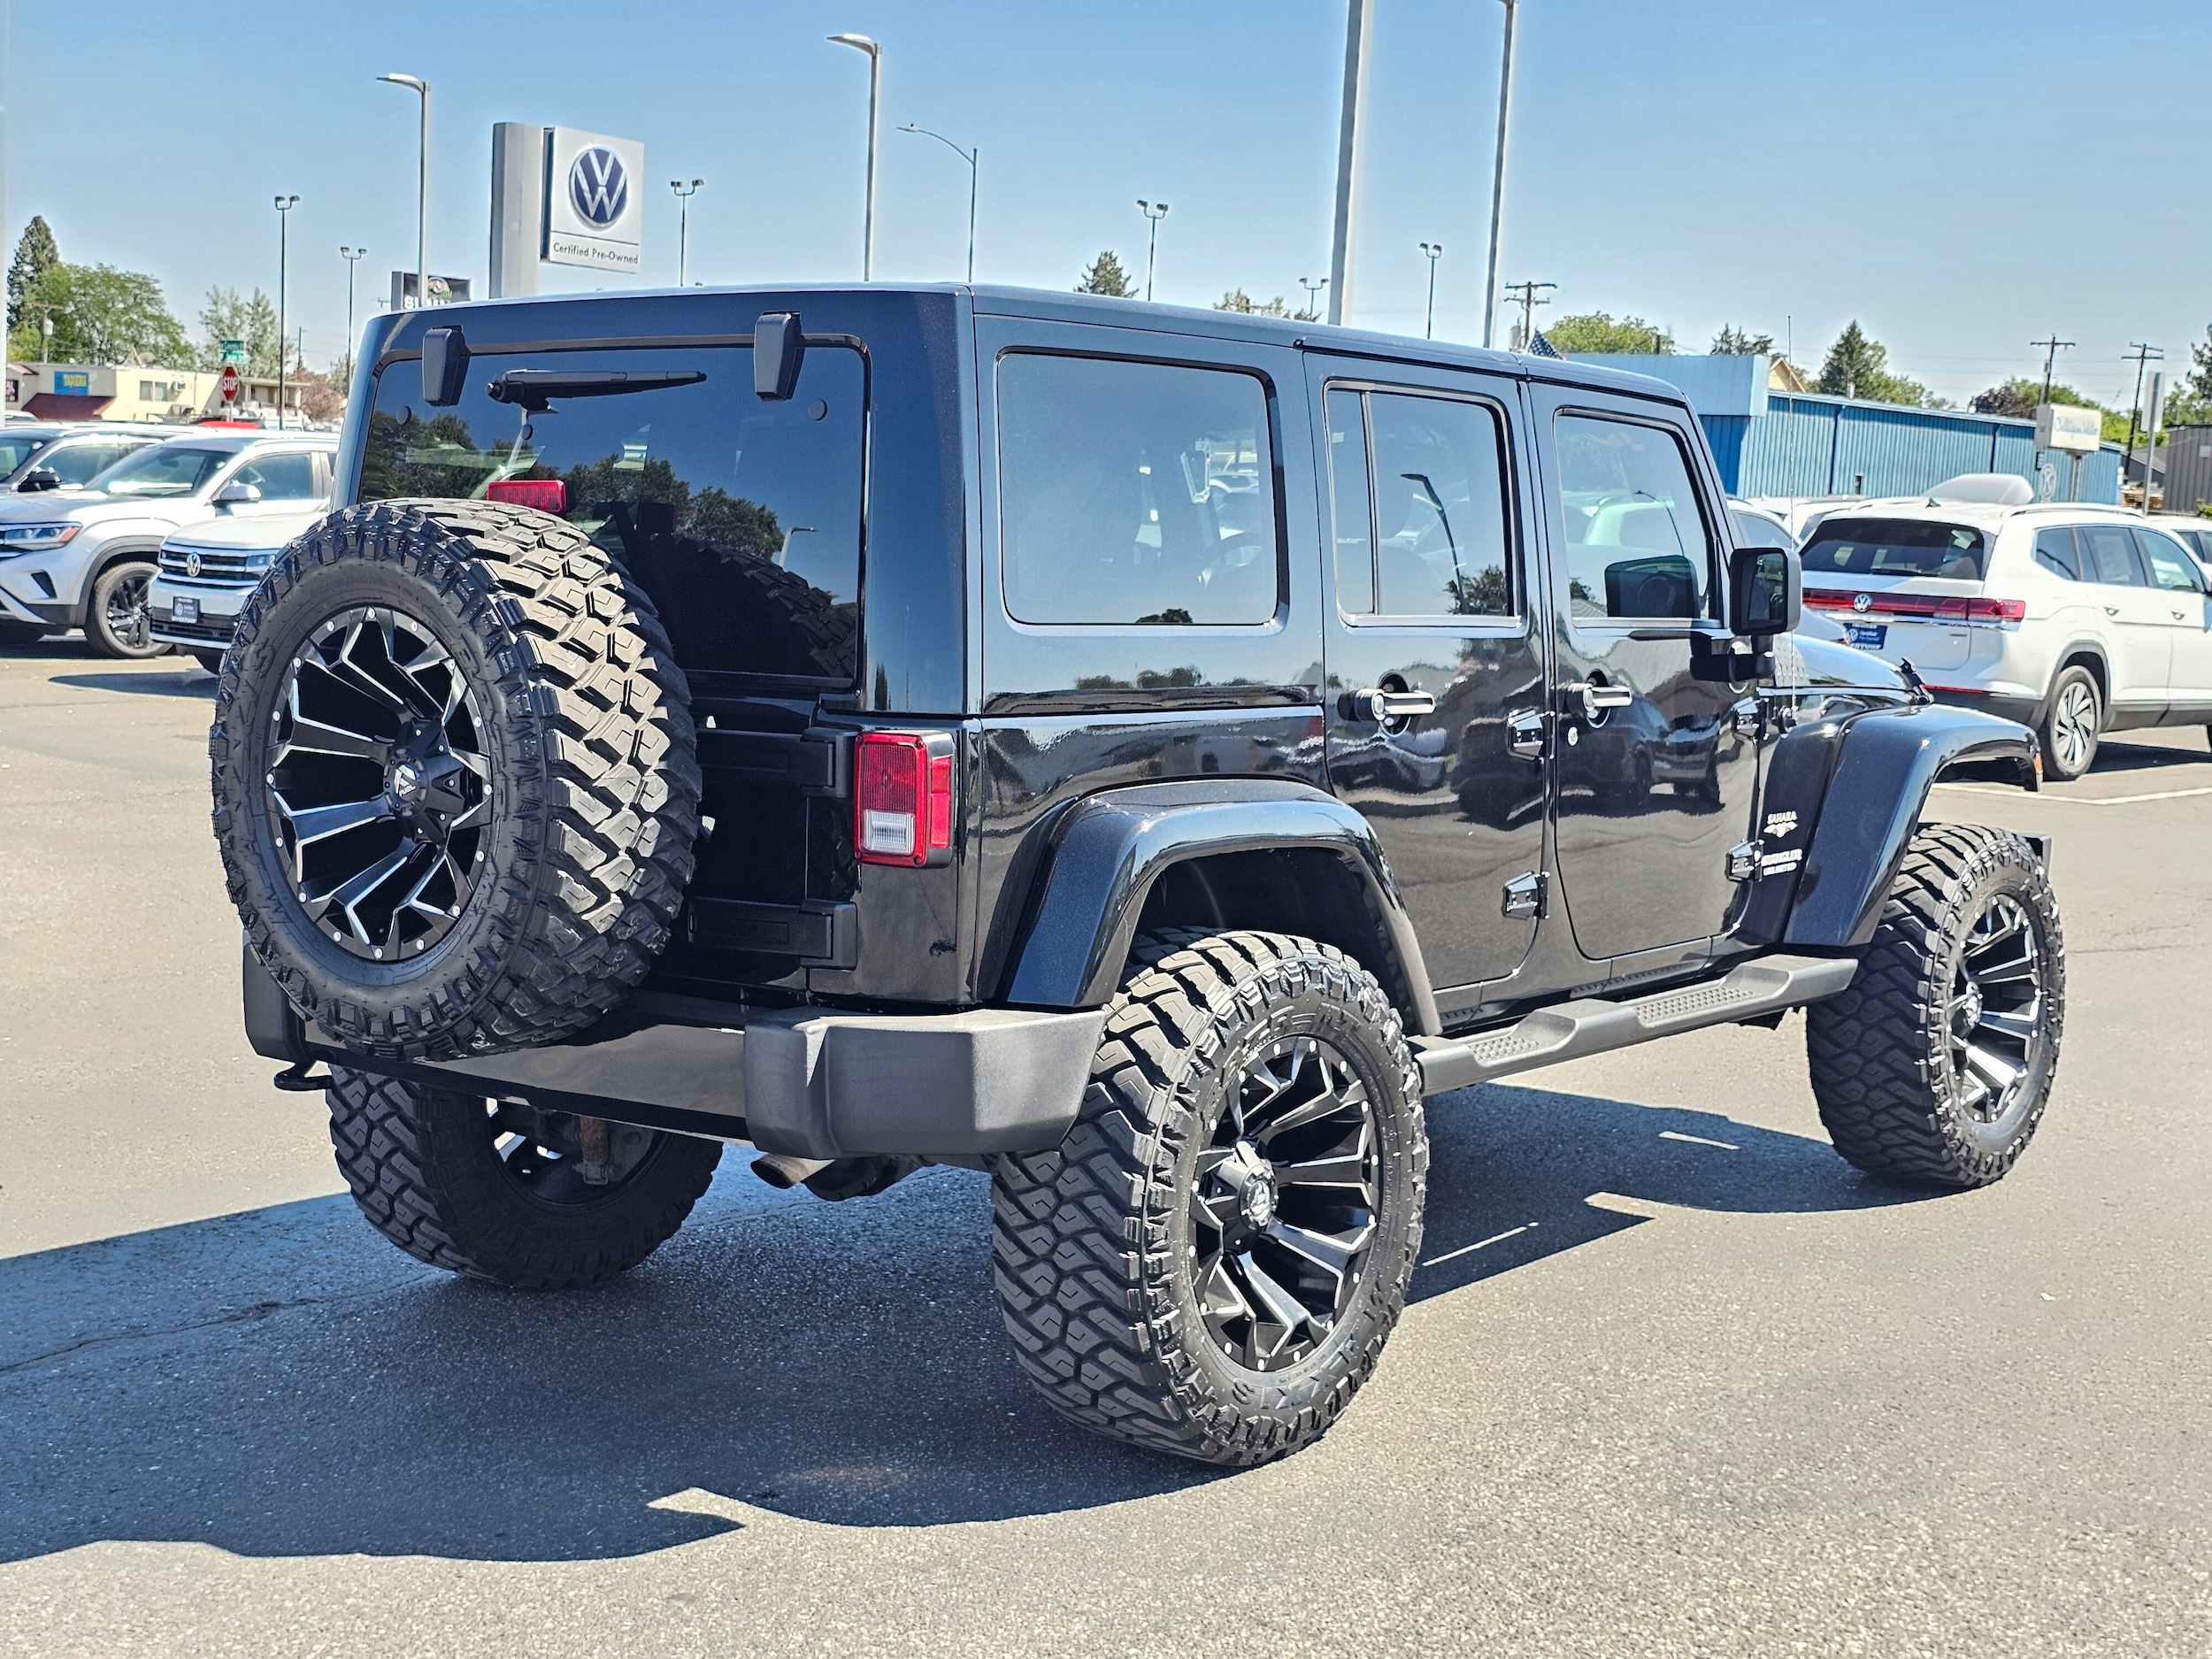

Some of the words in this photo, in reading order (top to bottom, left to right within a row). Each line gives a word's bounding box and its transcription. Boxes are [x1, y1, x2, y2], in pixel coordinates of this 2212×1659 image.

[553, 242, 589, 257] Certified
[592, 249, 639, 265] Pre-Owned
[223, 376, 238, 391] STOP
